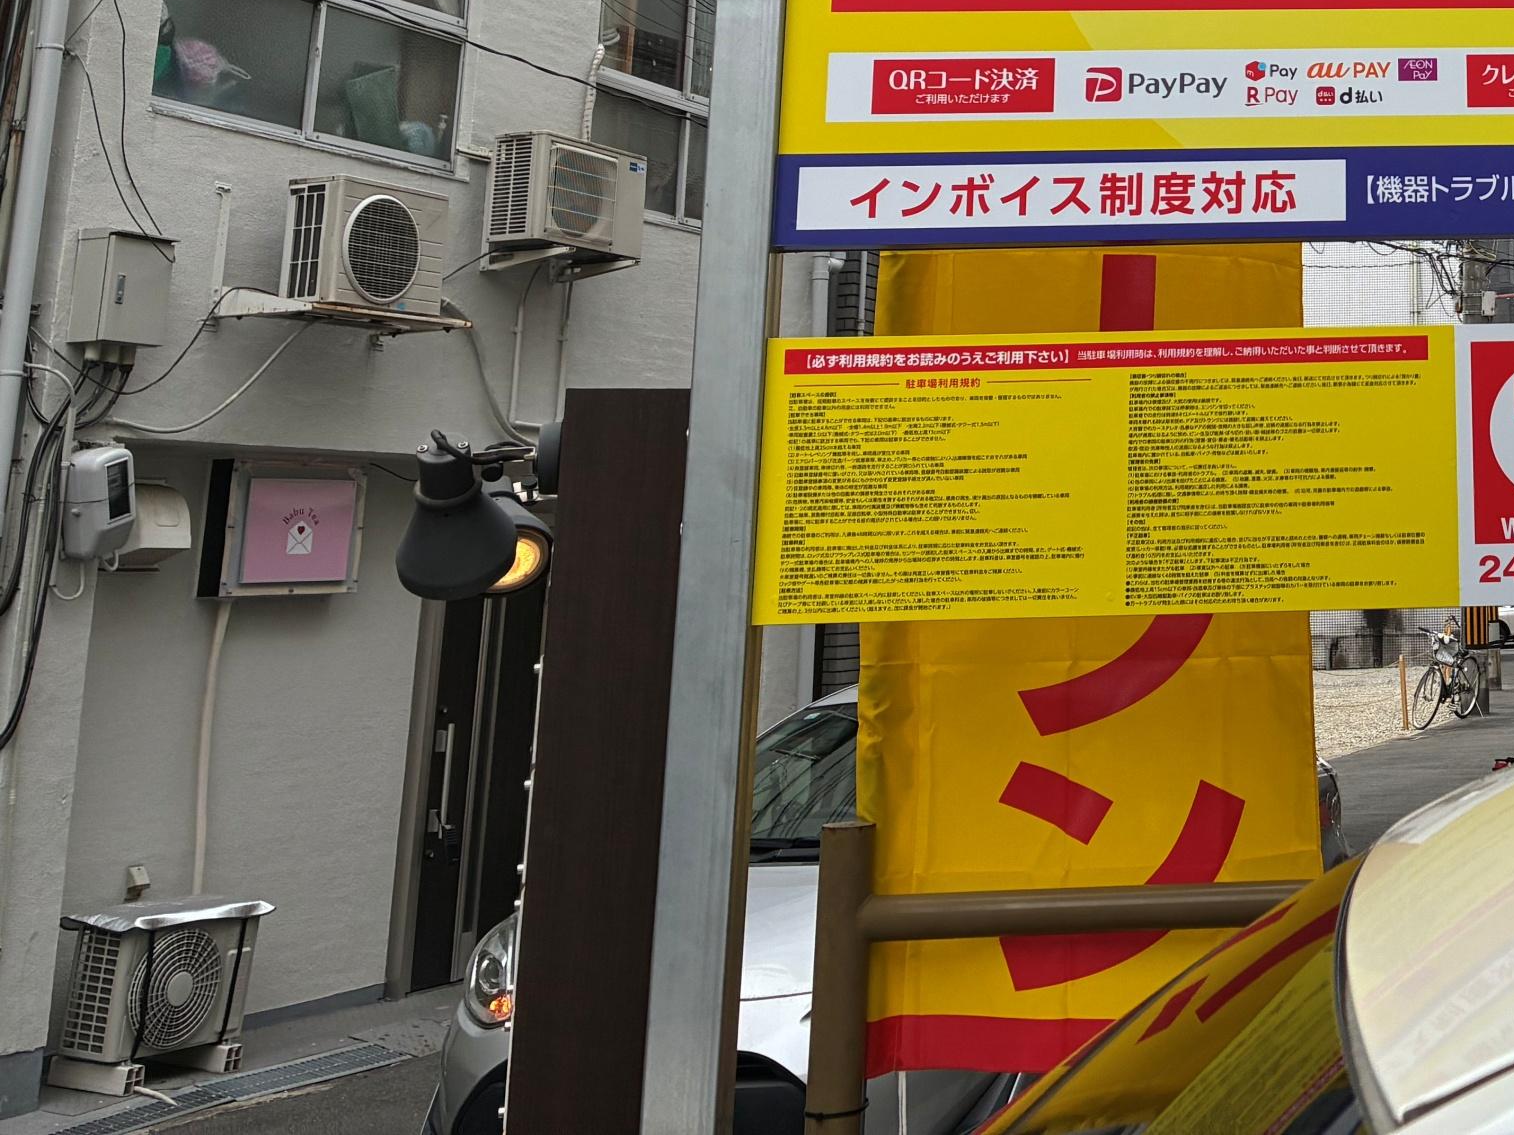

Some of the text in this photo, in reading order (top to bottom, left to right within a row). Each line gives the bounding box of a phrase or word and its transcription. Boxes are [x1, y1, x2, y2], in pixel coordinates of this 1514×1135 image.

[1269, 64, 1298, 81] Pay
[1306, 62, 1391, 78] au PAY
[888, 68, 1040, 92] QRコード決済
[1128, 72, 1228, 99] PayPay
[914, 93, 1011, 105] ご利用いただけます
[1339, 86, 1383, 105] d払い
[850, 171, 1298, 218] インボイス制度対応
